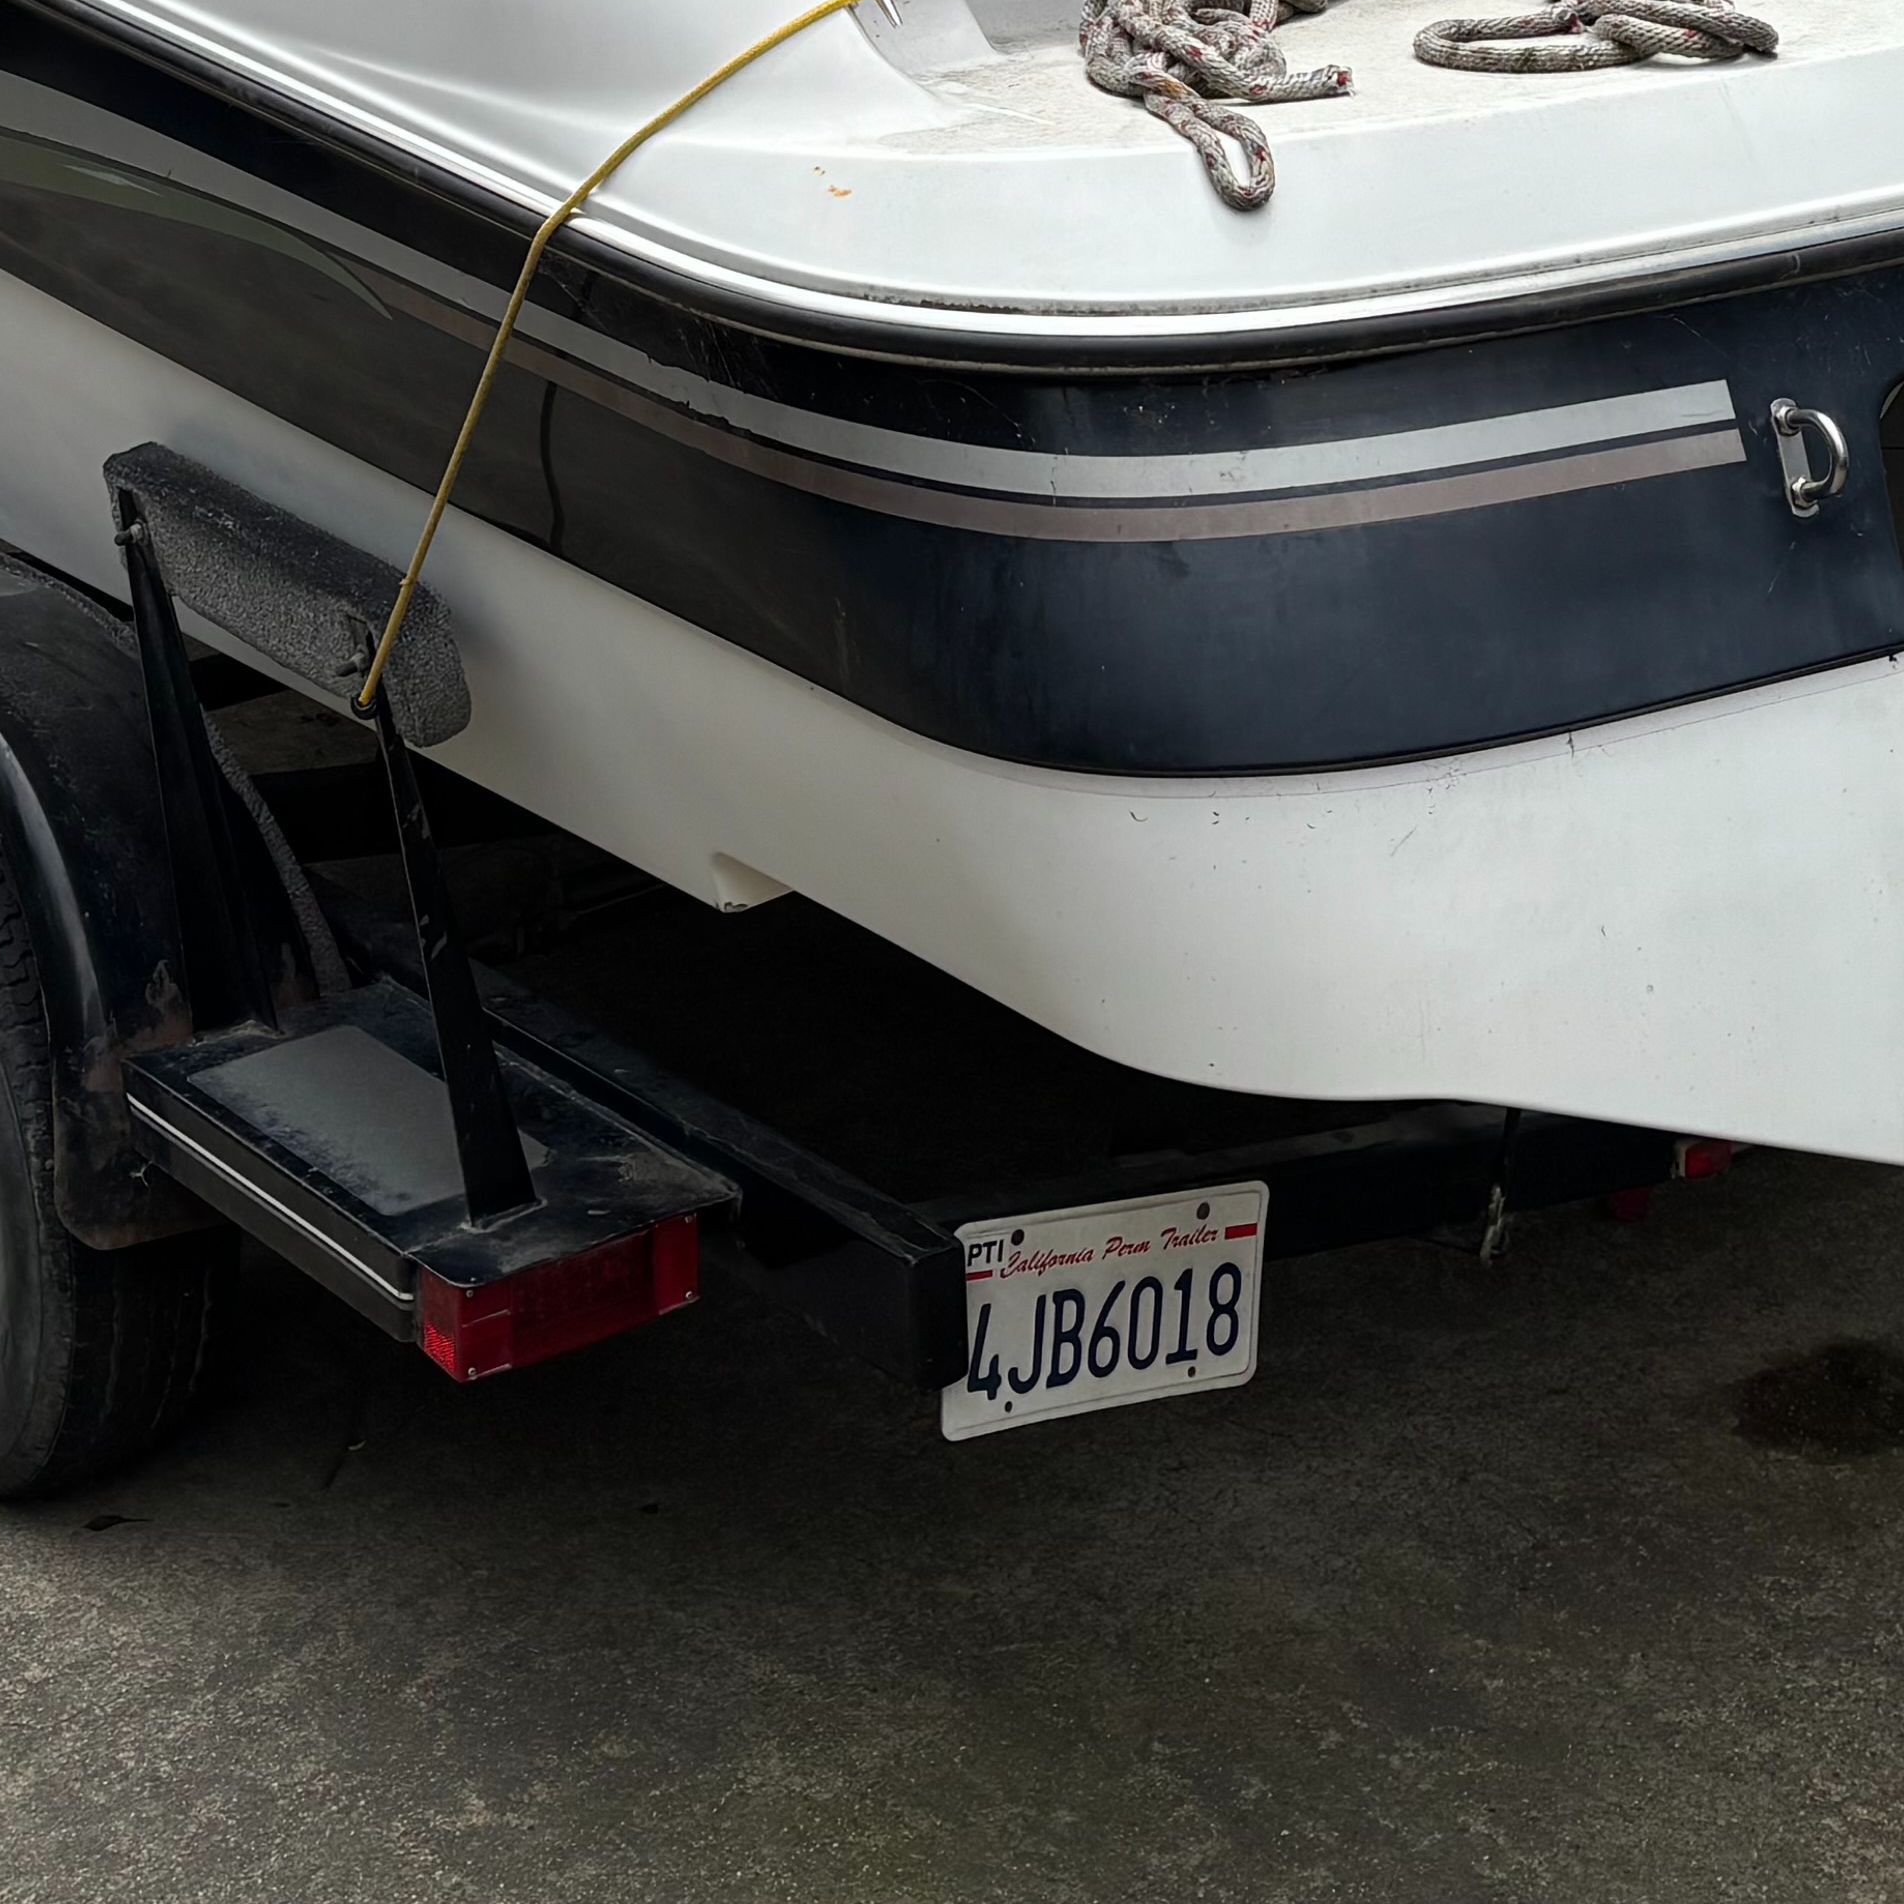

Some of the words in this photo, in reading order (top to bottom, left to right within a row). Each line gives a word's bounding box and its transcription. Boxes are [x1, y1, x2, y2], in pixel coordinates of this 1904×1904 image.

[967, 1239, 1004, 1266] PTI
[1000, 1247, 1094, 1279] California
[1102, 1236, 1151, 1260] Perm
[1160, 1224, 1219, 1250] Trailer
[967, 1261, 1242, 1401] 4JB6018
